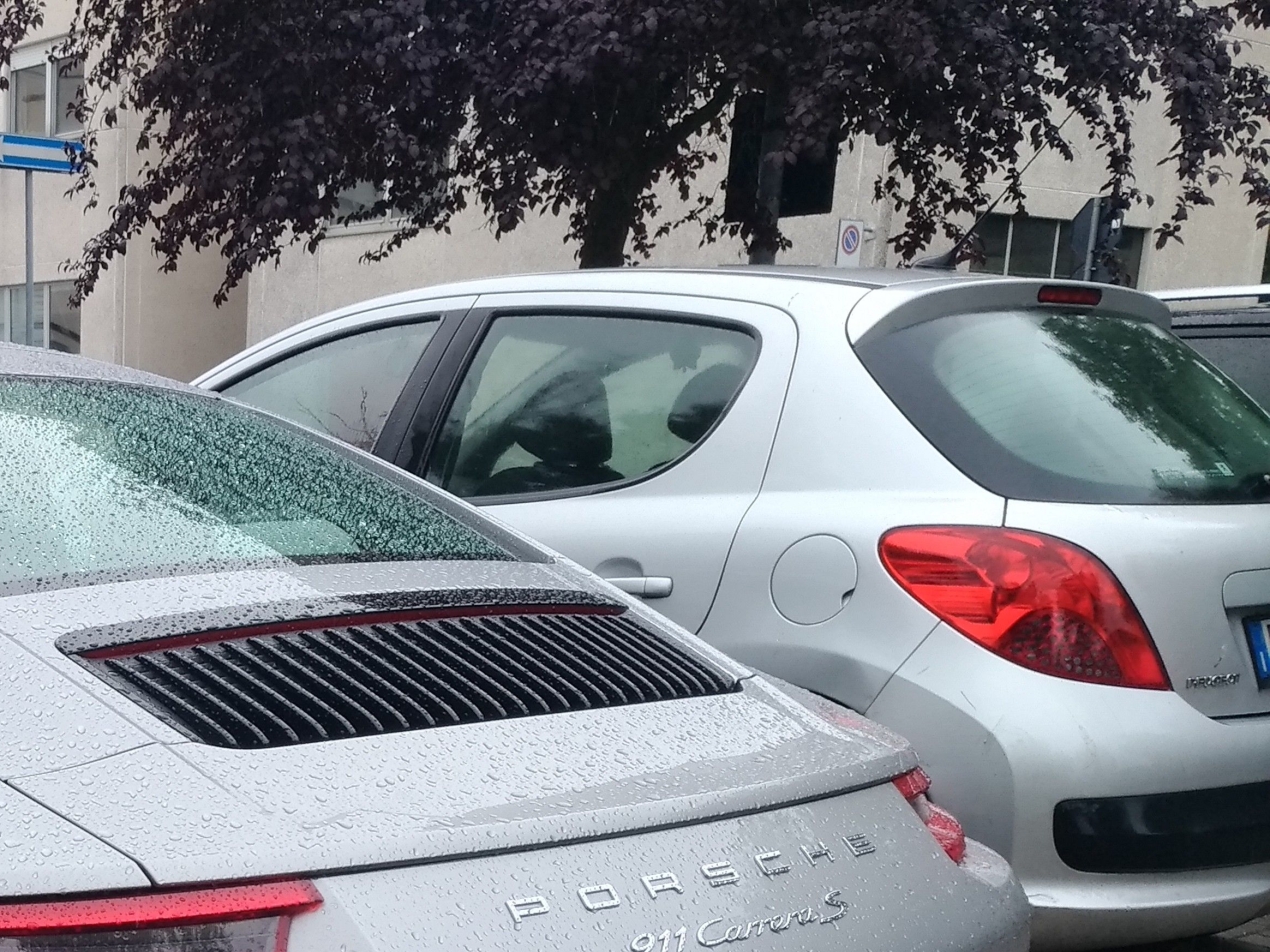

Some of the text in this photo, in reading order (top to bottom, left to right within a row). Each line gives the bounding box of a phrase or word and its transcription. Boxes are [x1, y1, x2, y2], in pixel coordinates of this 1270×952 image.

[506, 833, 876, 923] PORSCHE
[696, 906, 820, 947] Carrera
[819, 889, 850, 925] S
